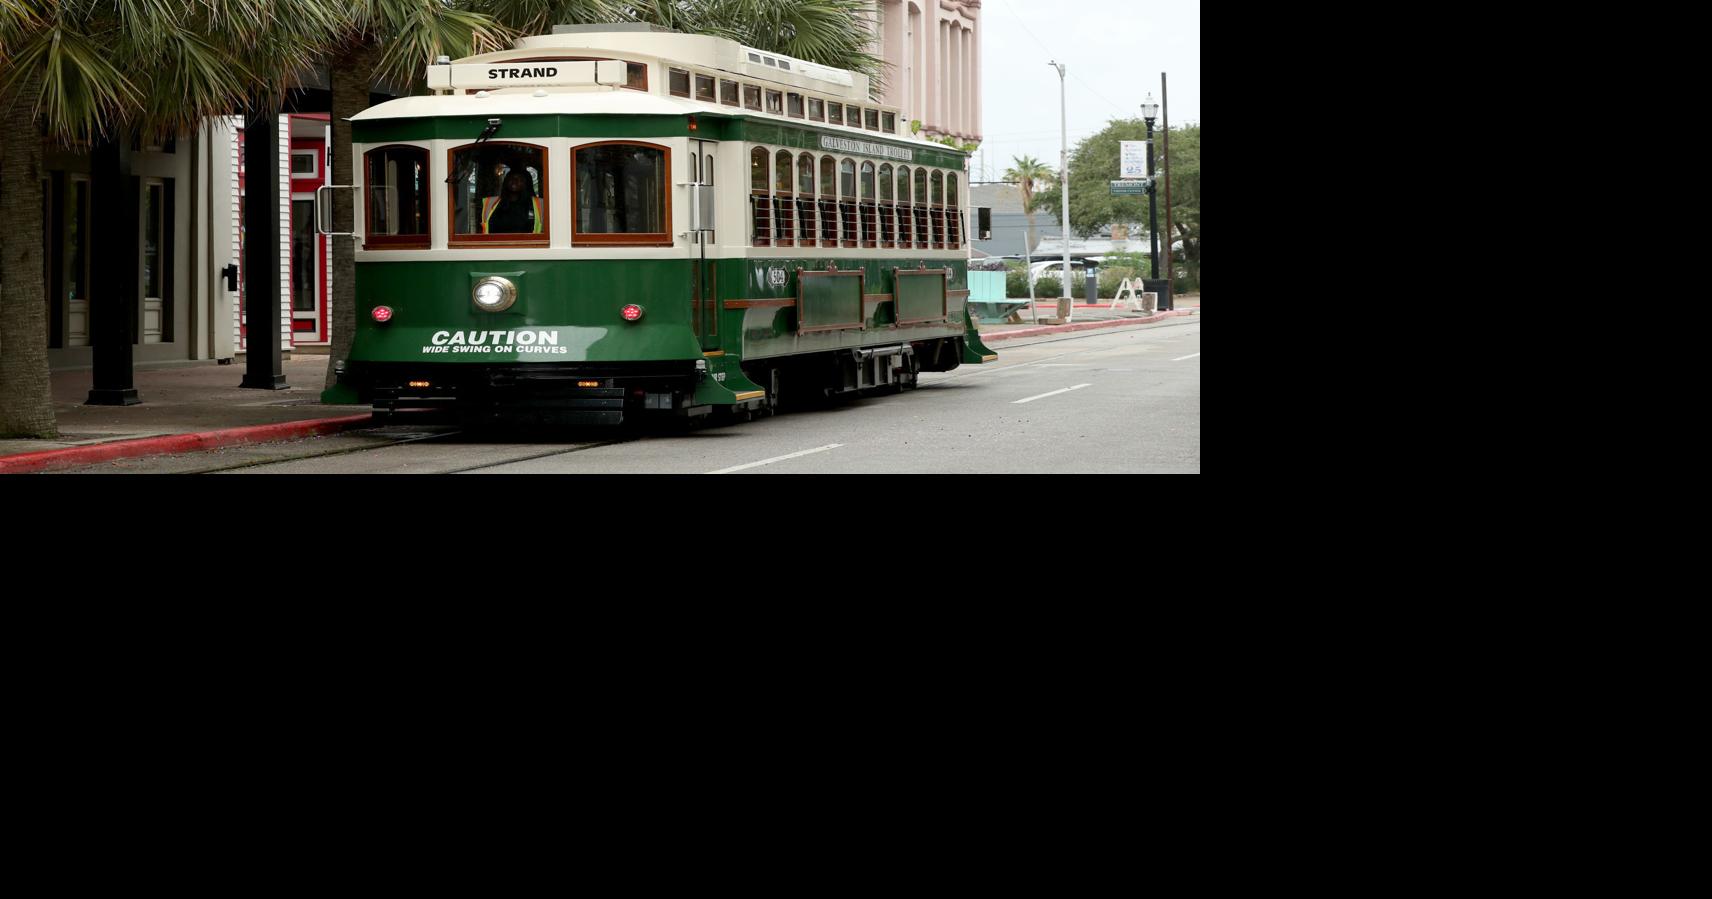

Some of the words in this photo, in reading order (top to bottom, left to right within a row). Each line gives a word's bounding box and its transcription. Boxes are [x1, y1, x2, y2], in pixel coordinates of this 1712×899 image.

[488, 67, 558, 79] STRAND
[823, 136, 860, 152] GALVESTON
[863, 141, 884, 155] ISLAND
[887, 146, 912, 159] TROLLEY
[431, 330, 558, 345] CAUTION
[422, 346, 450, 354] WIDE
[452, 345, 492, 353] SWING
[494, 345, 513, 353] ON
[515, 345, 568, 354] CURVES
